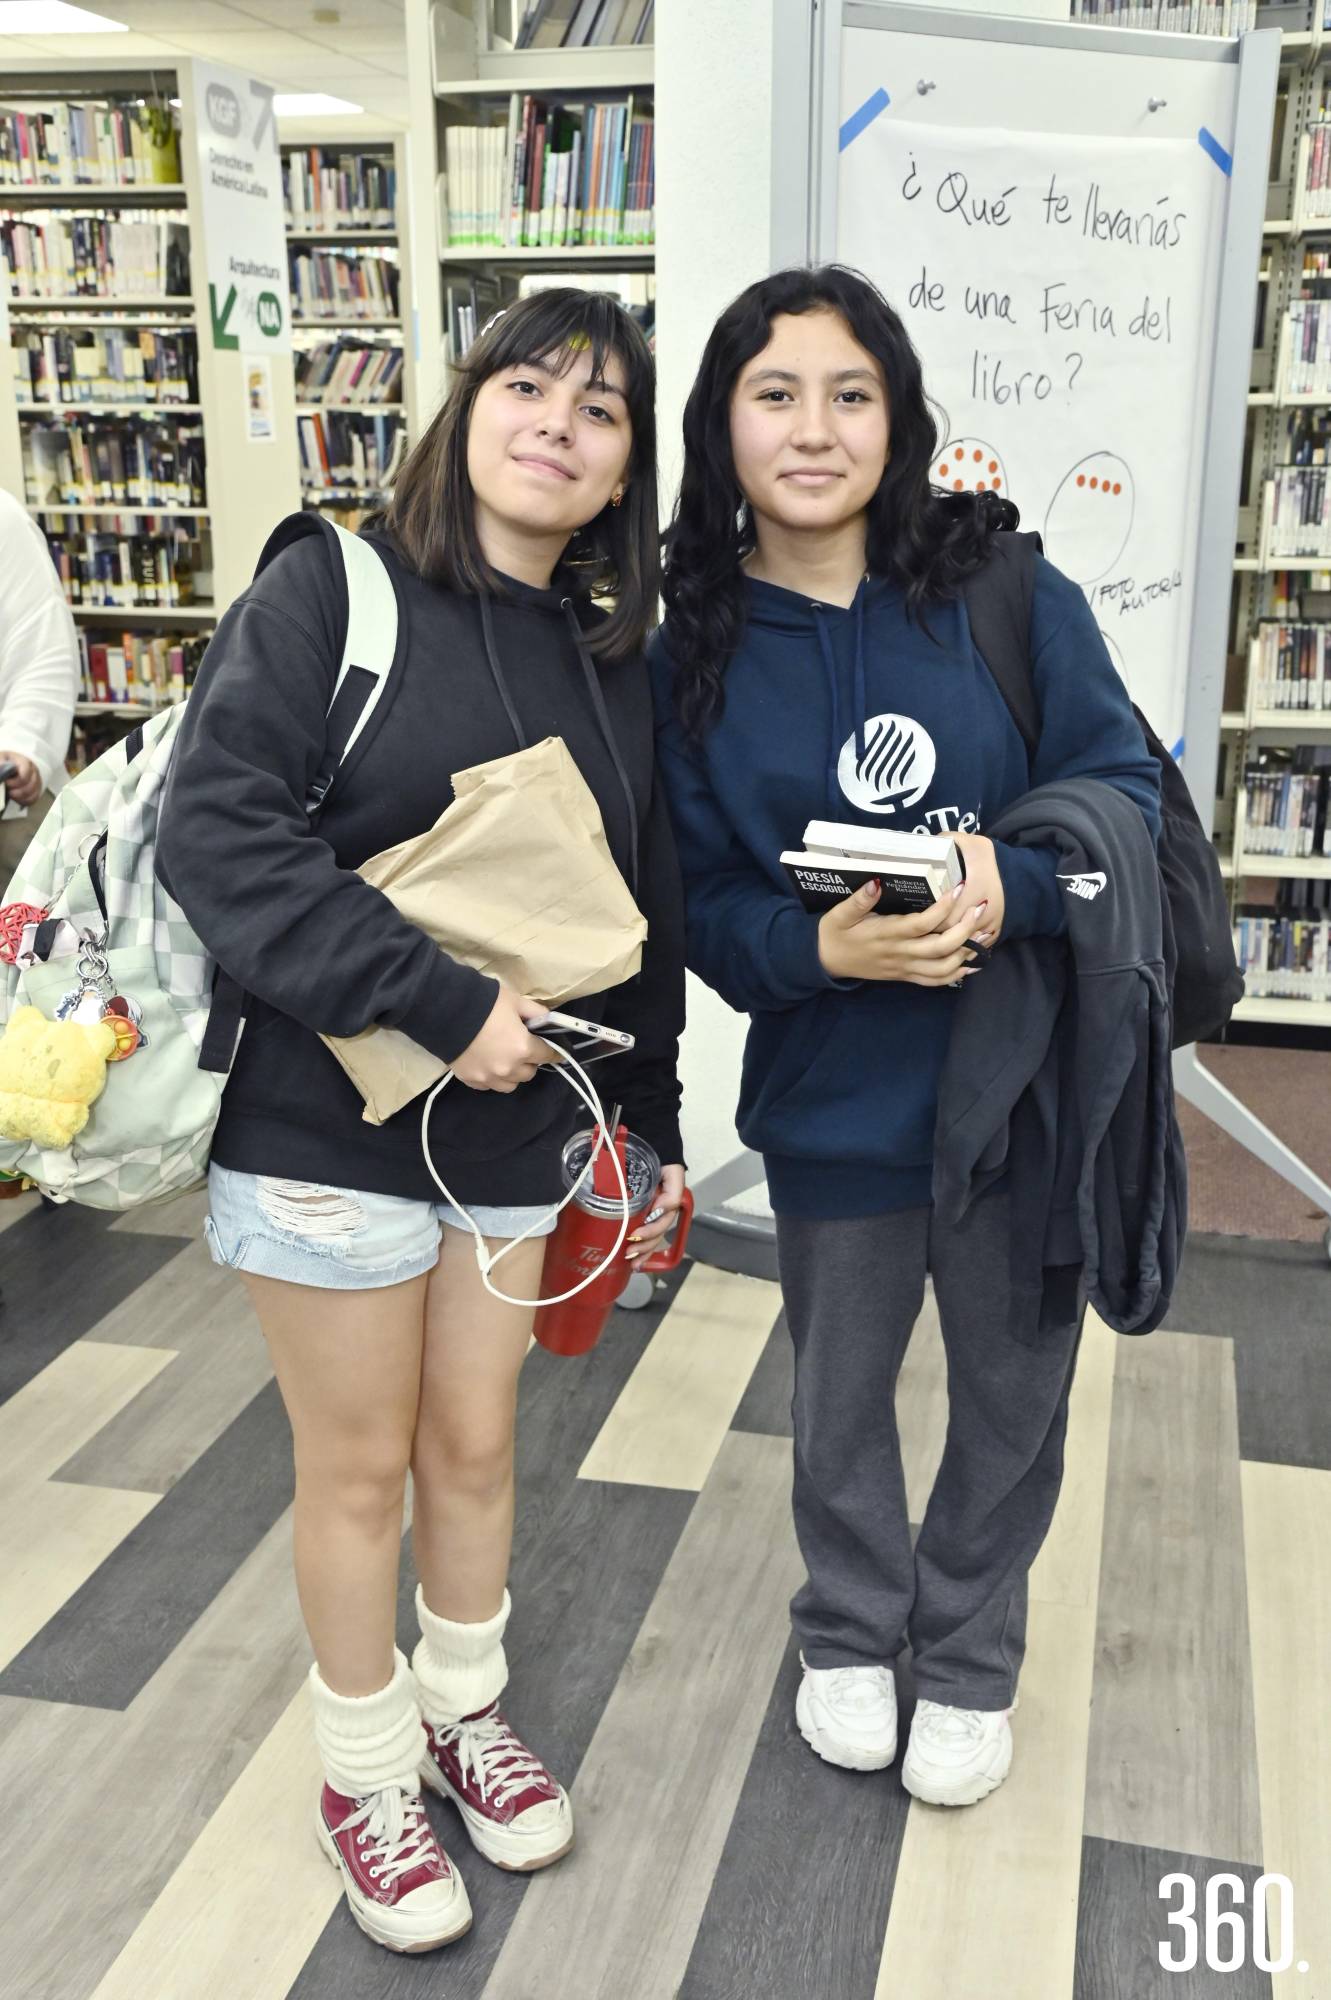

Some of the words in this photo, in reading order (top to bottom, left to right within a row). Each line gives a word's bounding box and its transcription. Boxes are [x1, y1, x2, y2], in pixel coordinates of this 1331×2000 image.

[1042, 173, 1072, 224] te
[909, 265, 945, 312] de
[965, 286, 1017, 325] una
[1040, 282, 1116, 337] Feria
[1128, 295, 1172, 343] del
[794, 869, 845, 885] POESÍA
[893, 879, 925, 887] Roberto
[800, 881, 853, 895] ESCOGIDA
[1066, 879, 1100, 900] NIKE
